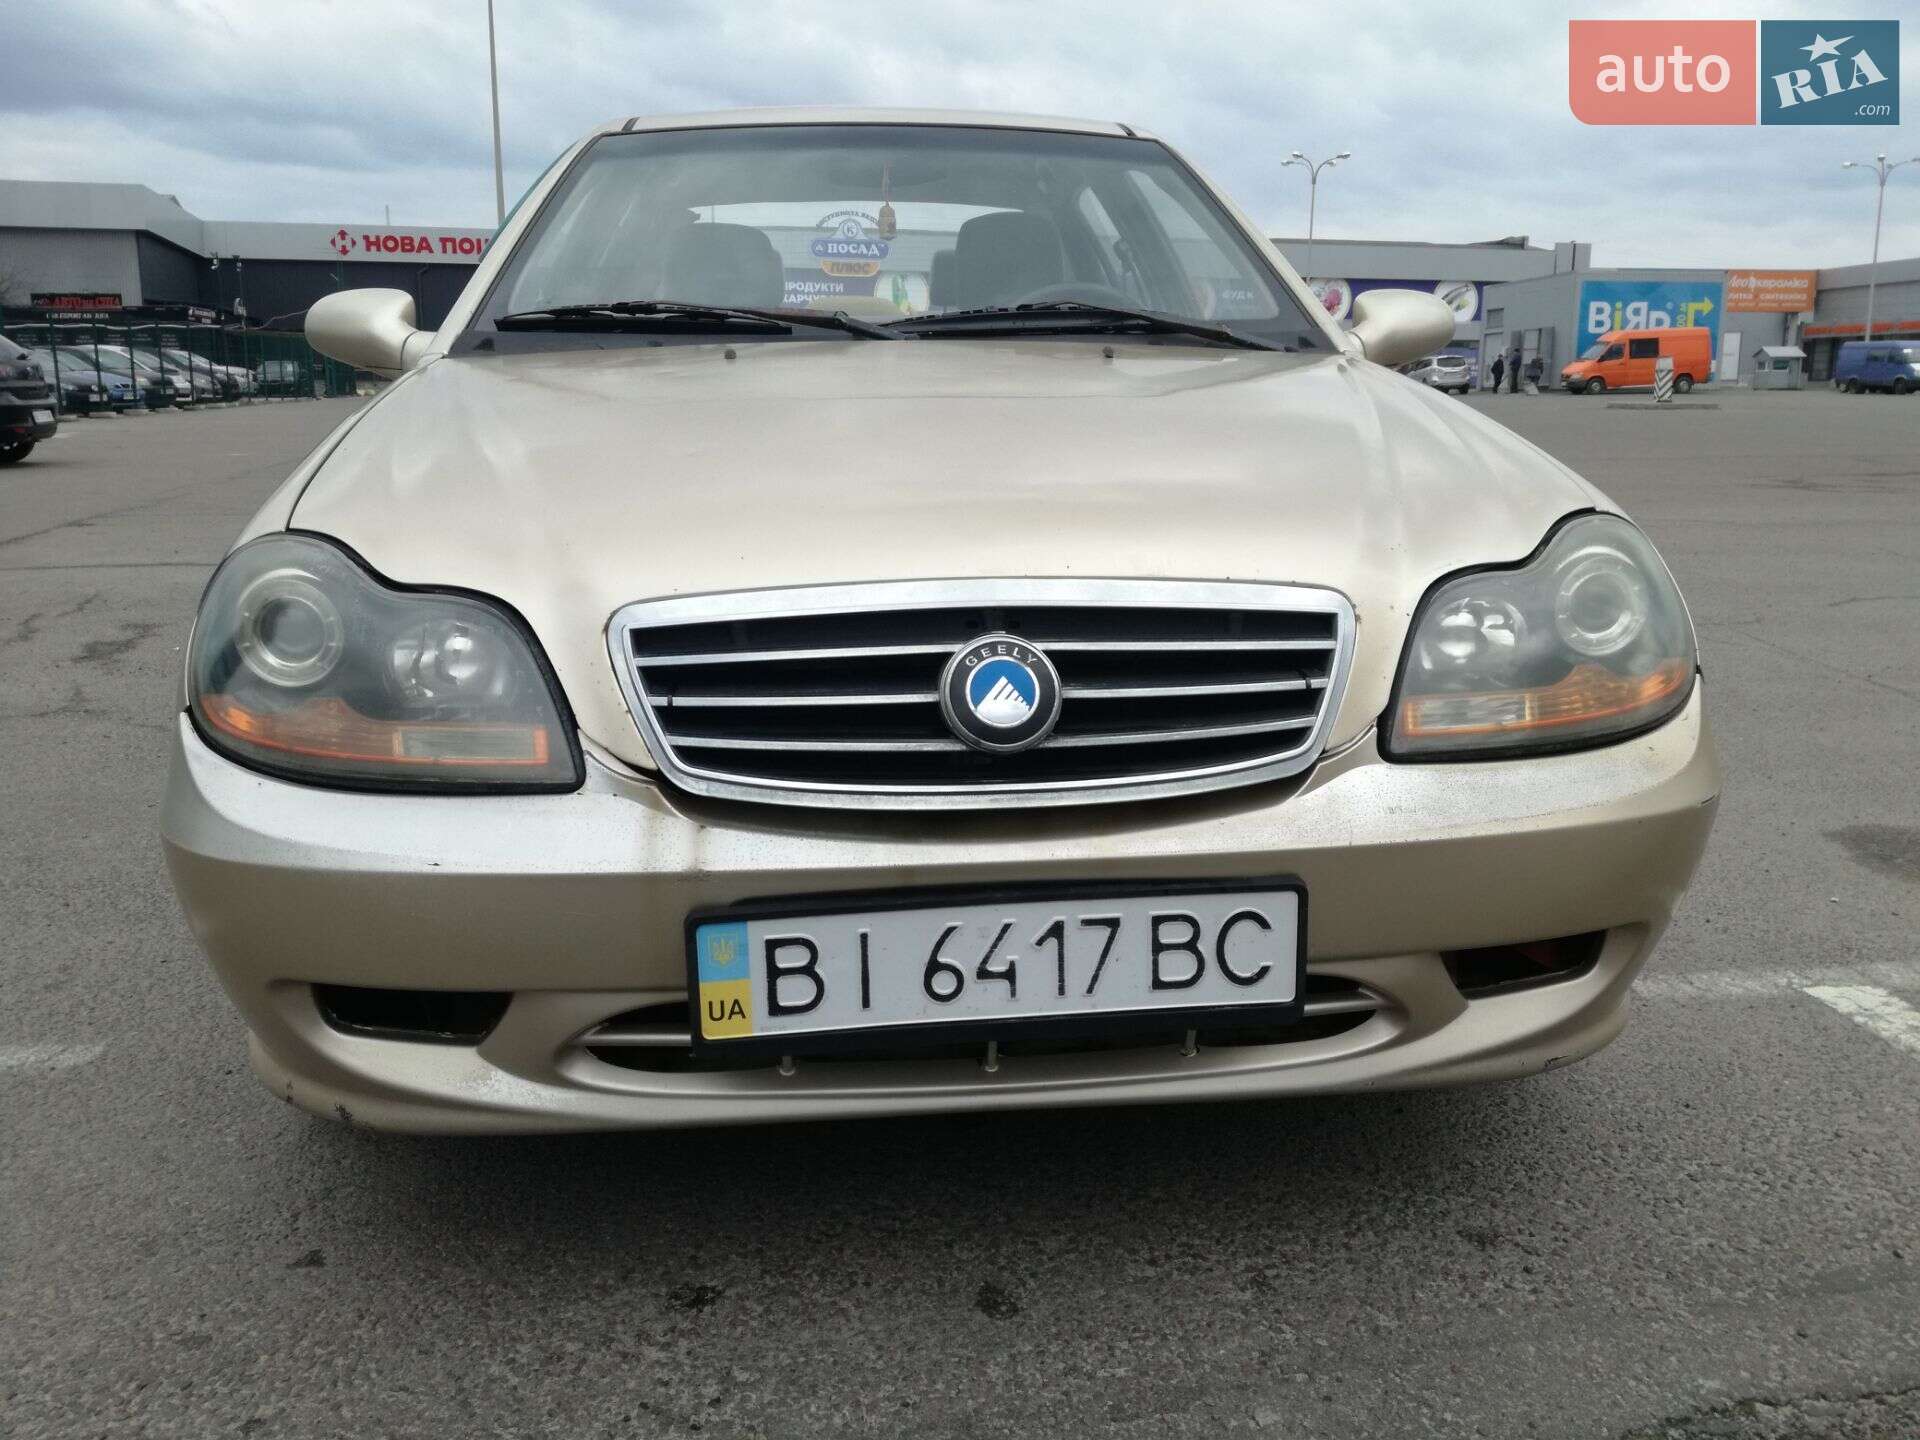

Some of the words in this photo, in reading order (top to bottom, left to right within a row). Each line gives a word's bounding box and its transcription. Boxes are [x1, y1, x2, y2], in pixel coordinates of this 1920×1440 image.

[363, 234, 434, 254] НОВА
[827, 243, 880, 257] ПОСАД
[966, 644, 1038, 666] GEELY
[766, 929, 871, 1017] BI
[923, 914, 1122, 1001] 6417
[1151, 910, 1273, 990] BC
[708, 1000, 746, 1022] UA
